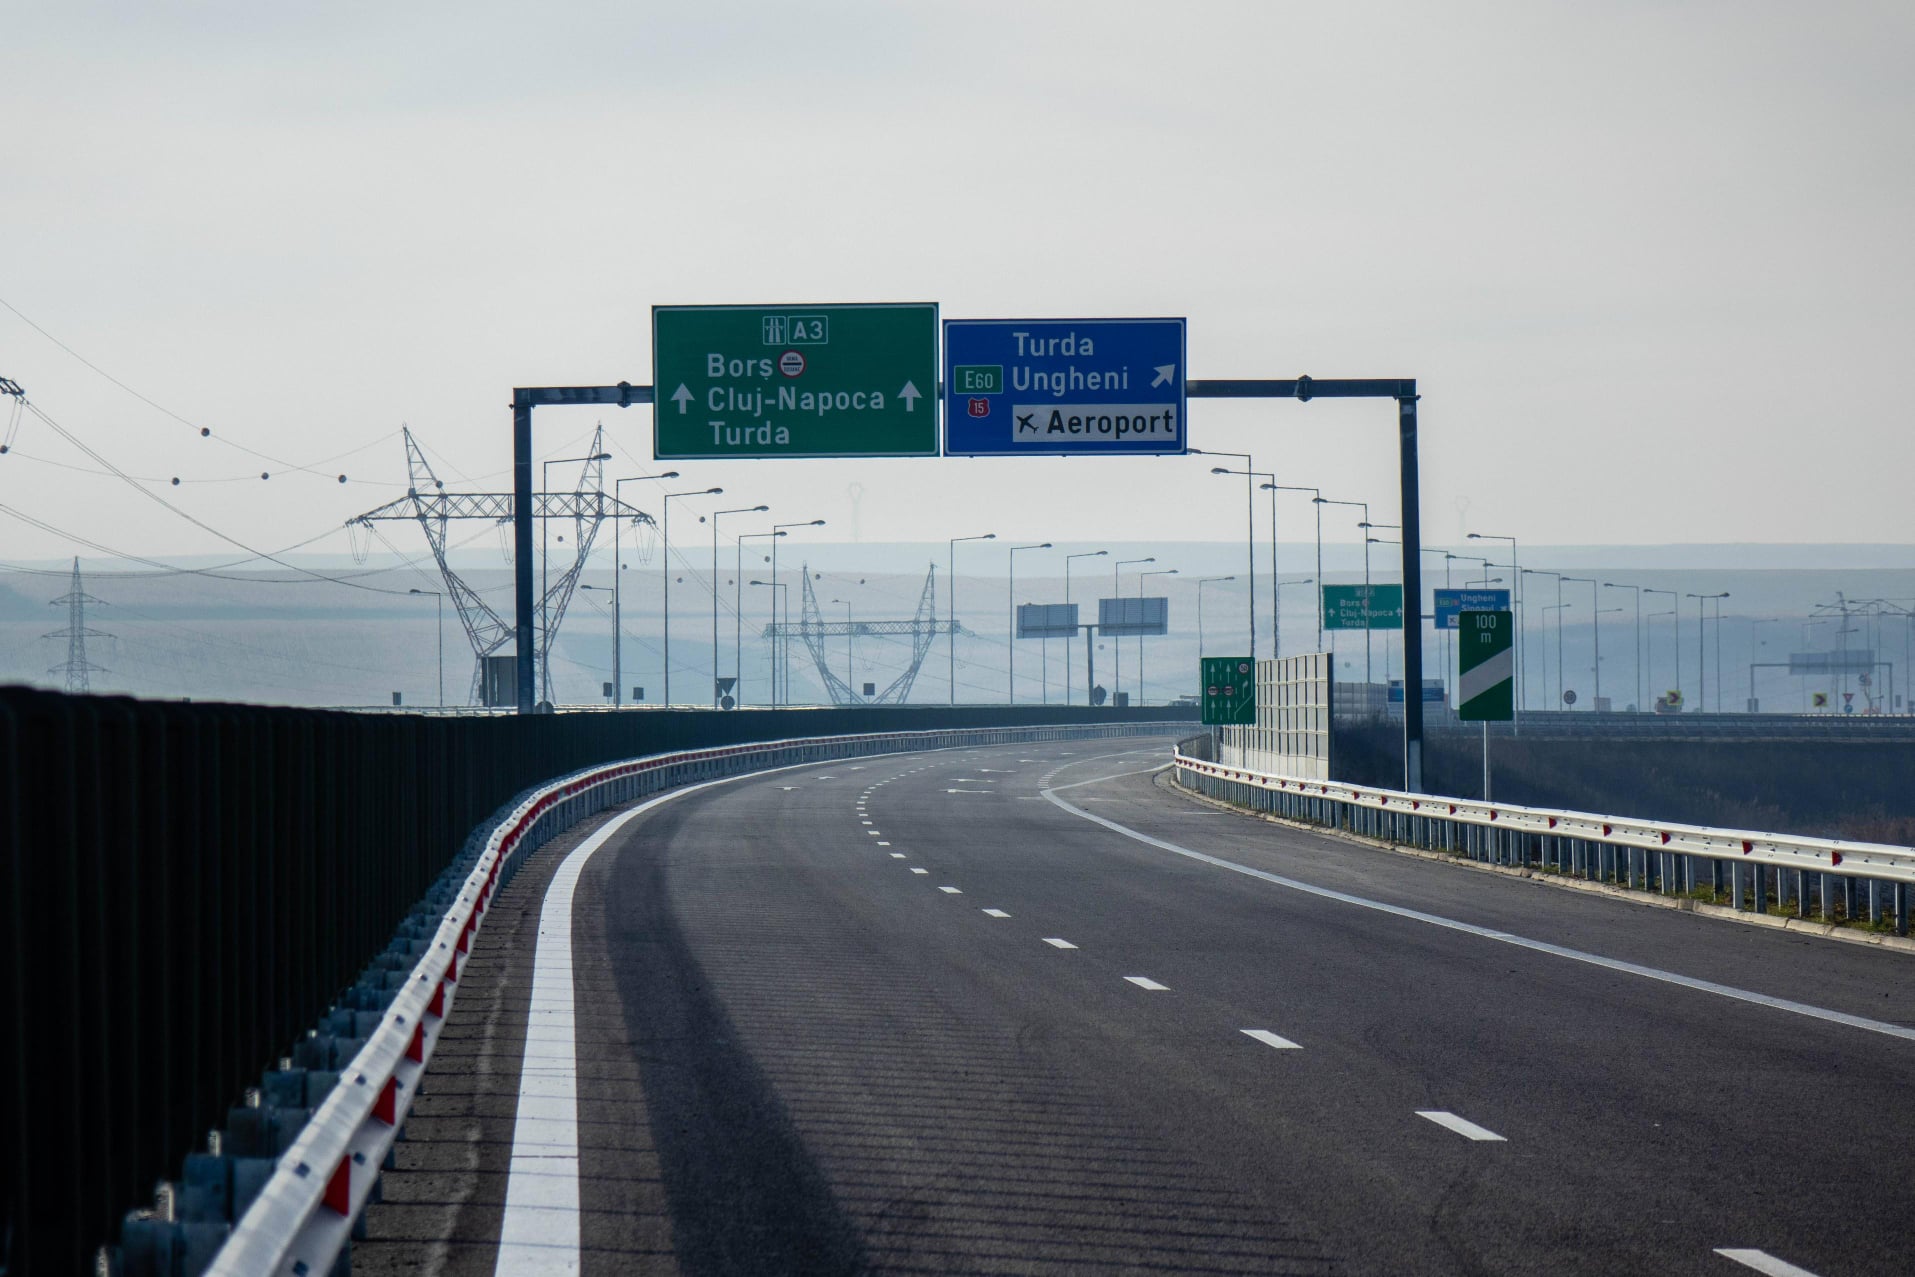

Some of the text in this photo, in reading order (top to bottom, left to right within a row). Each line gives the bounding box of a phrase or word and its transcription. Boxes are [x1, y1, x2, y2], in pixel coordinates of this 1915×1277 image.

[793, 321, 823, 340] A3
[1012, 332, 1094, 357] Turda
[707, 353, 773, 381] Borș
[965, 370, 993, 389] E60
[1012, 366, 1128, 397] Ungheni
[708, 386, 885, 417] Cluj-Napoca
[974, 402, 984, 414] 15
[708, 420, 790, 445] Turda
[1047, 409, 1174, 440] Aeroport
[1460, 593, 1496, 604] Ungheni
[1340, 608, 1394, 618] Cluj-Napoca
[1476, 614, 1497, 629] 100
[1480, 632, 1492, 644] m
